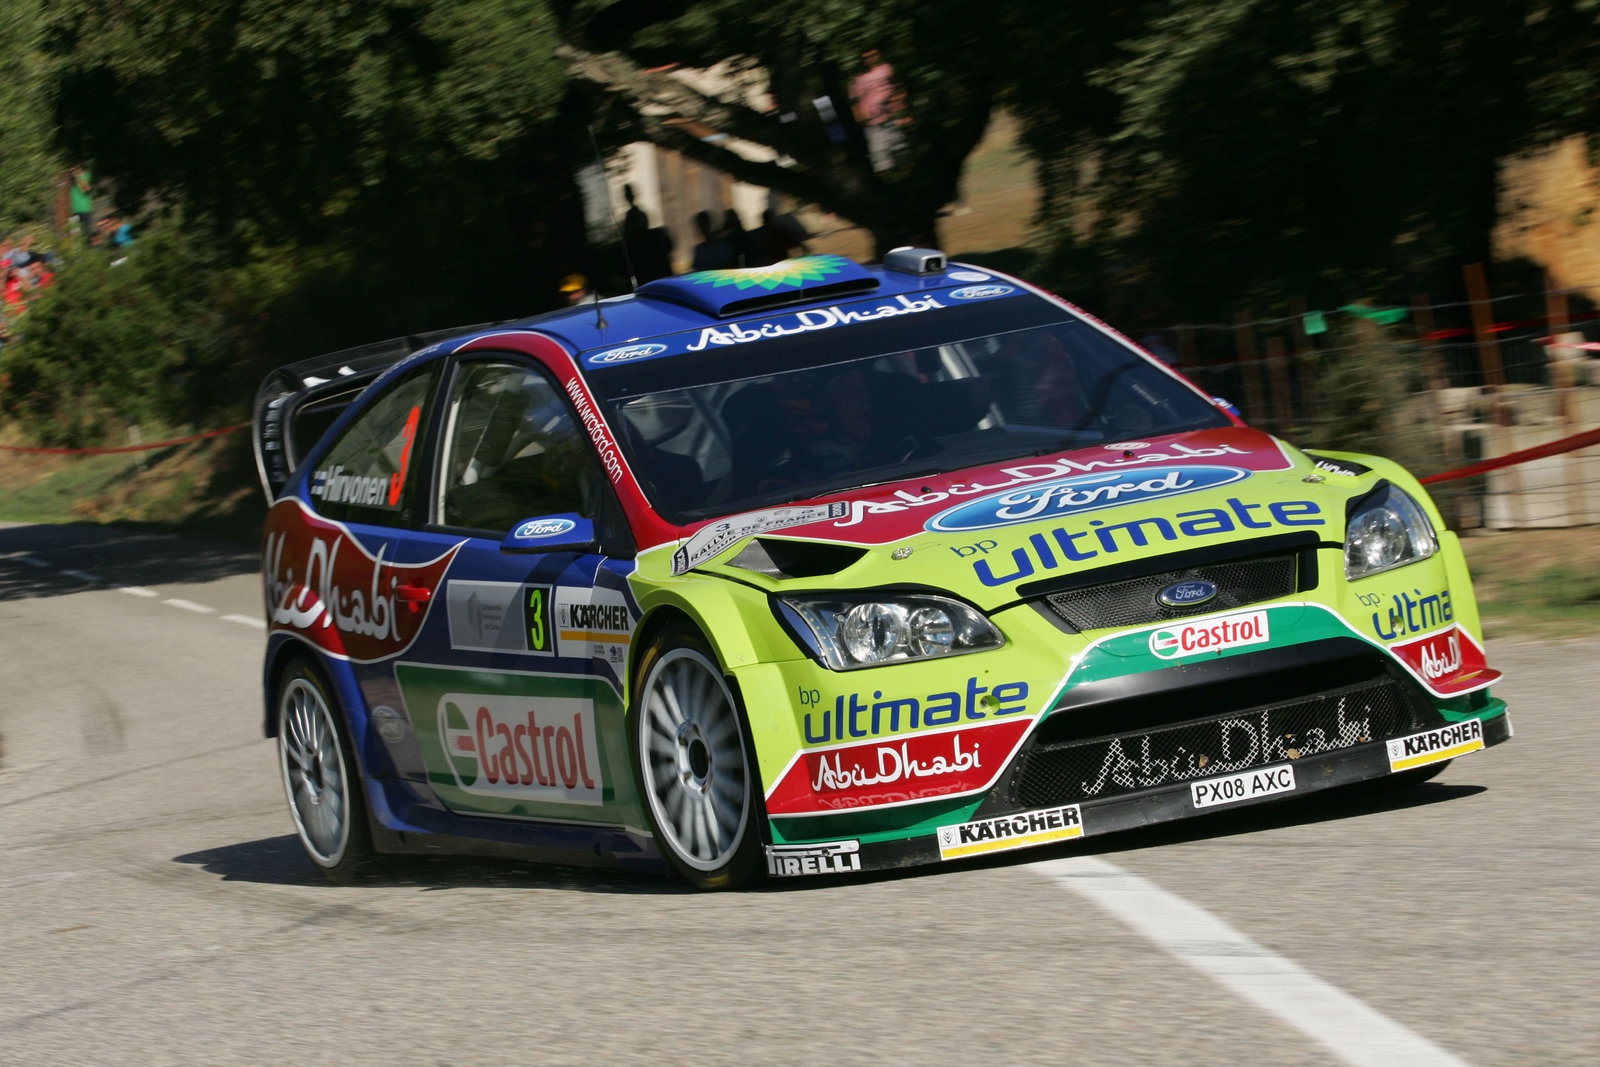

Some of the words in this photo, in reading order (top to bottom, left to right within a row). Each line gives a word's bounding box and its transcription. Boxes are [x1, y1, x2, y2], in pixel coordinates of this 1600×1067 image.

[604, 346, 653, 361] Ford
[566, 377, 623, 484] www.wrcford.com
[321, 465, 388, 506] Hirvonen
[996, 471, 1195, 520] Ford
[523, 521, 563, 536] Ford
[691, 530, 732, 562] RALLYE
[766, 510, 826, 526] FRANCE
[716, 523, 731, 533] 3
[973, 498, 1326, 587] ultimate
[951, 539, 998, 560] bp
[1175, 584, 1205, 600] Ford
[1355, 592, 1381, 608] bp
[530, 589, 545, 650] 3
[570, 603, 629, 631] KÄRCHER
[1181, 615, 1263, 651] Castrol
[798, 686, 820, 706] bp
[804, 677, 1029, 744] ultimate
[476, 706, 595, 790] Castrol
[1403, 721, 1481, 757] KÄRCHER
[1195, 778, 1244, 804] PX08
[1252, 769, 1291, 794] AXC
[959, 807, 1079, 844] KÄRCHER
[765, 839, 861, 875] PIRELLI
